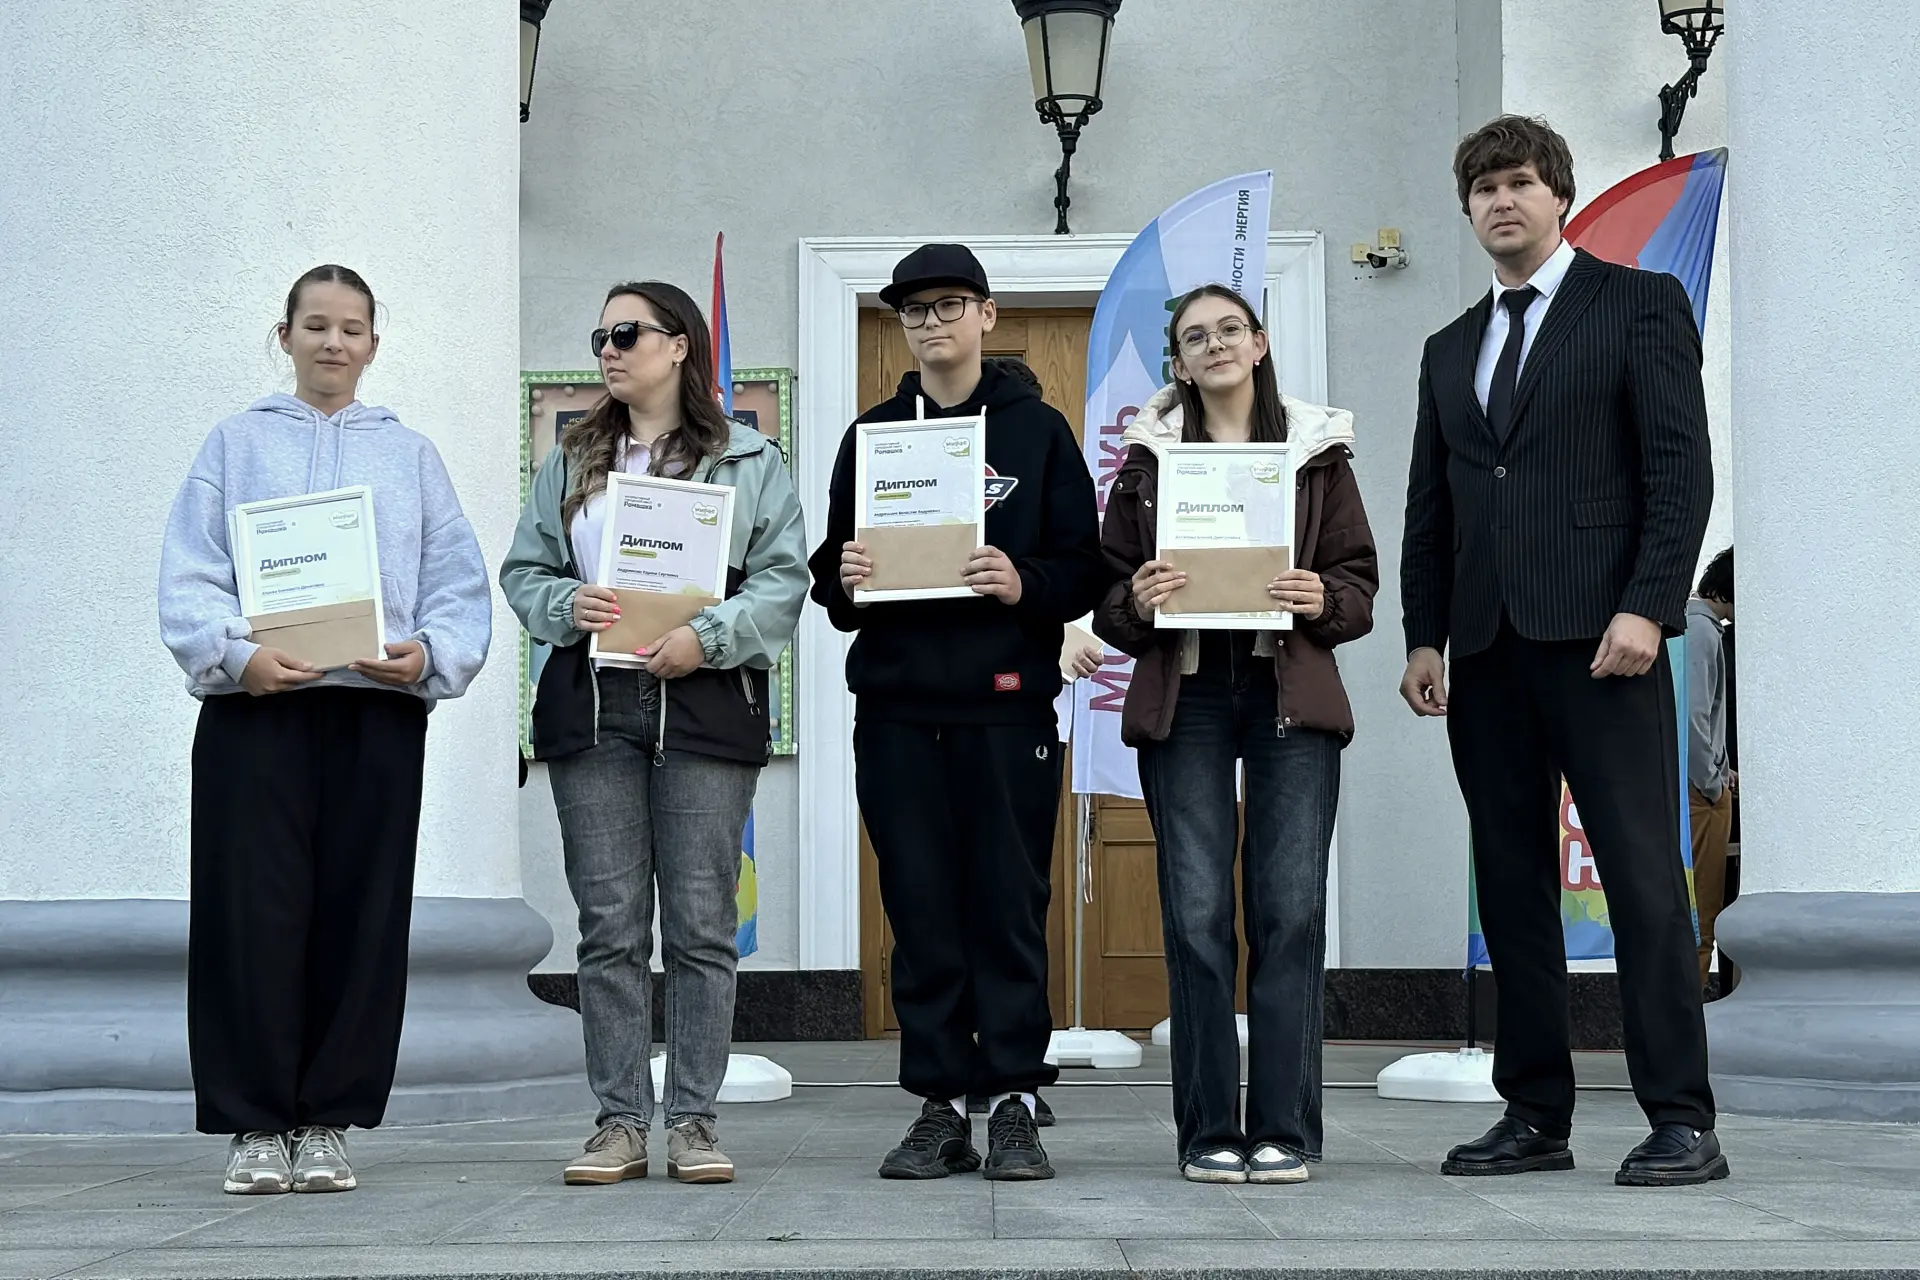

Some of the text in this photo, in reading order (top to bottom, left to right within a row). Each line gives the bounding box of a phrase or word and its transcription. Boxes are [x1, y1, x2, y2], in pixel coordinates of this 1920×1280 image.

[1235, 189, 1250, 241] ЭНЕРГИЯ
[874, 479, 938, 492] Диплом
[1176, 501, 1244, 514] Диплом
[620, 534, 684, 552] Диплом
[260, 552, 327, 572] Диплом
